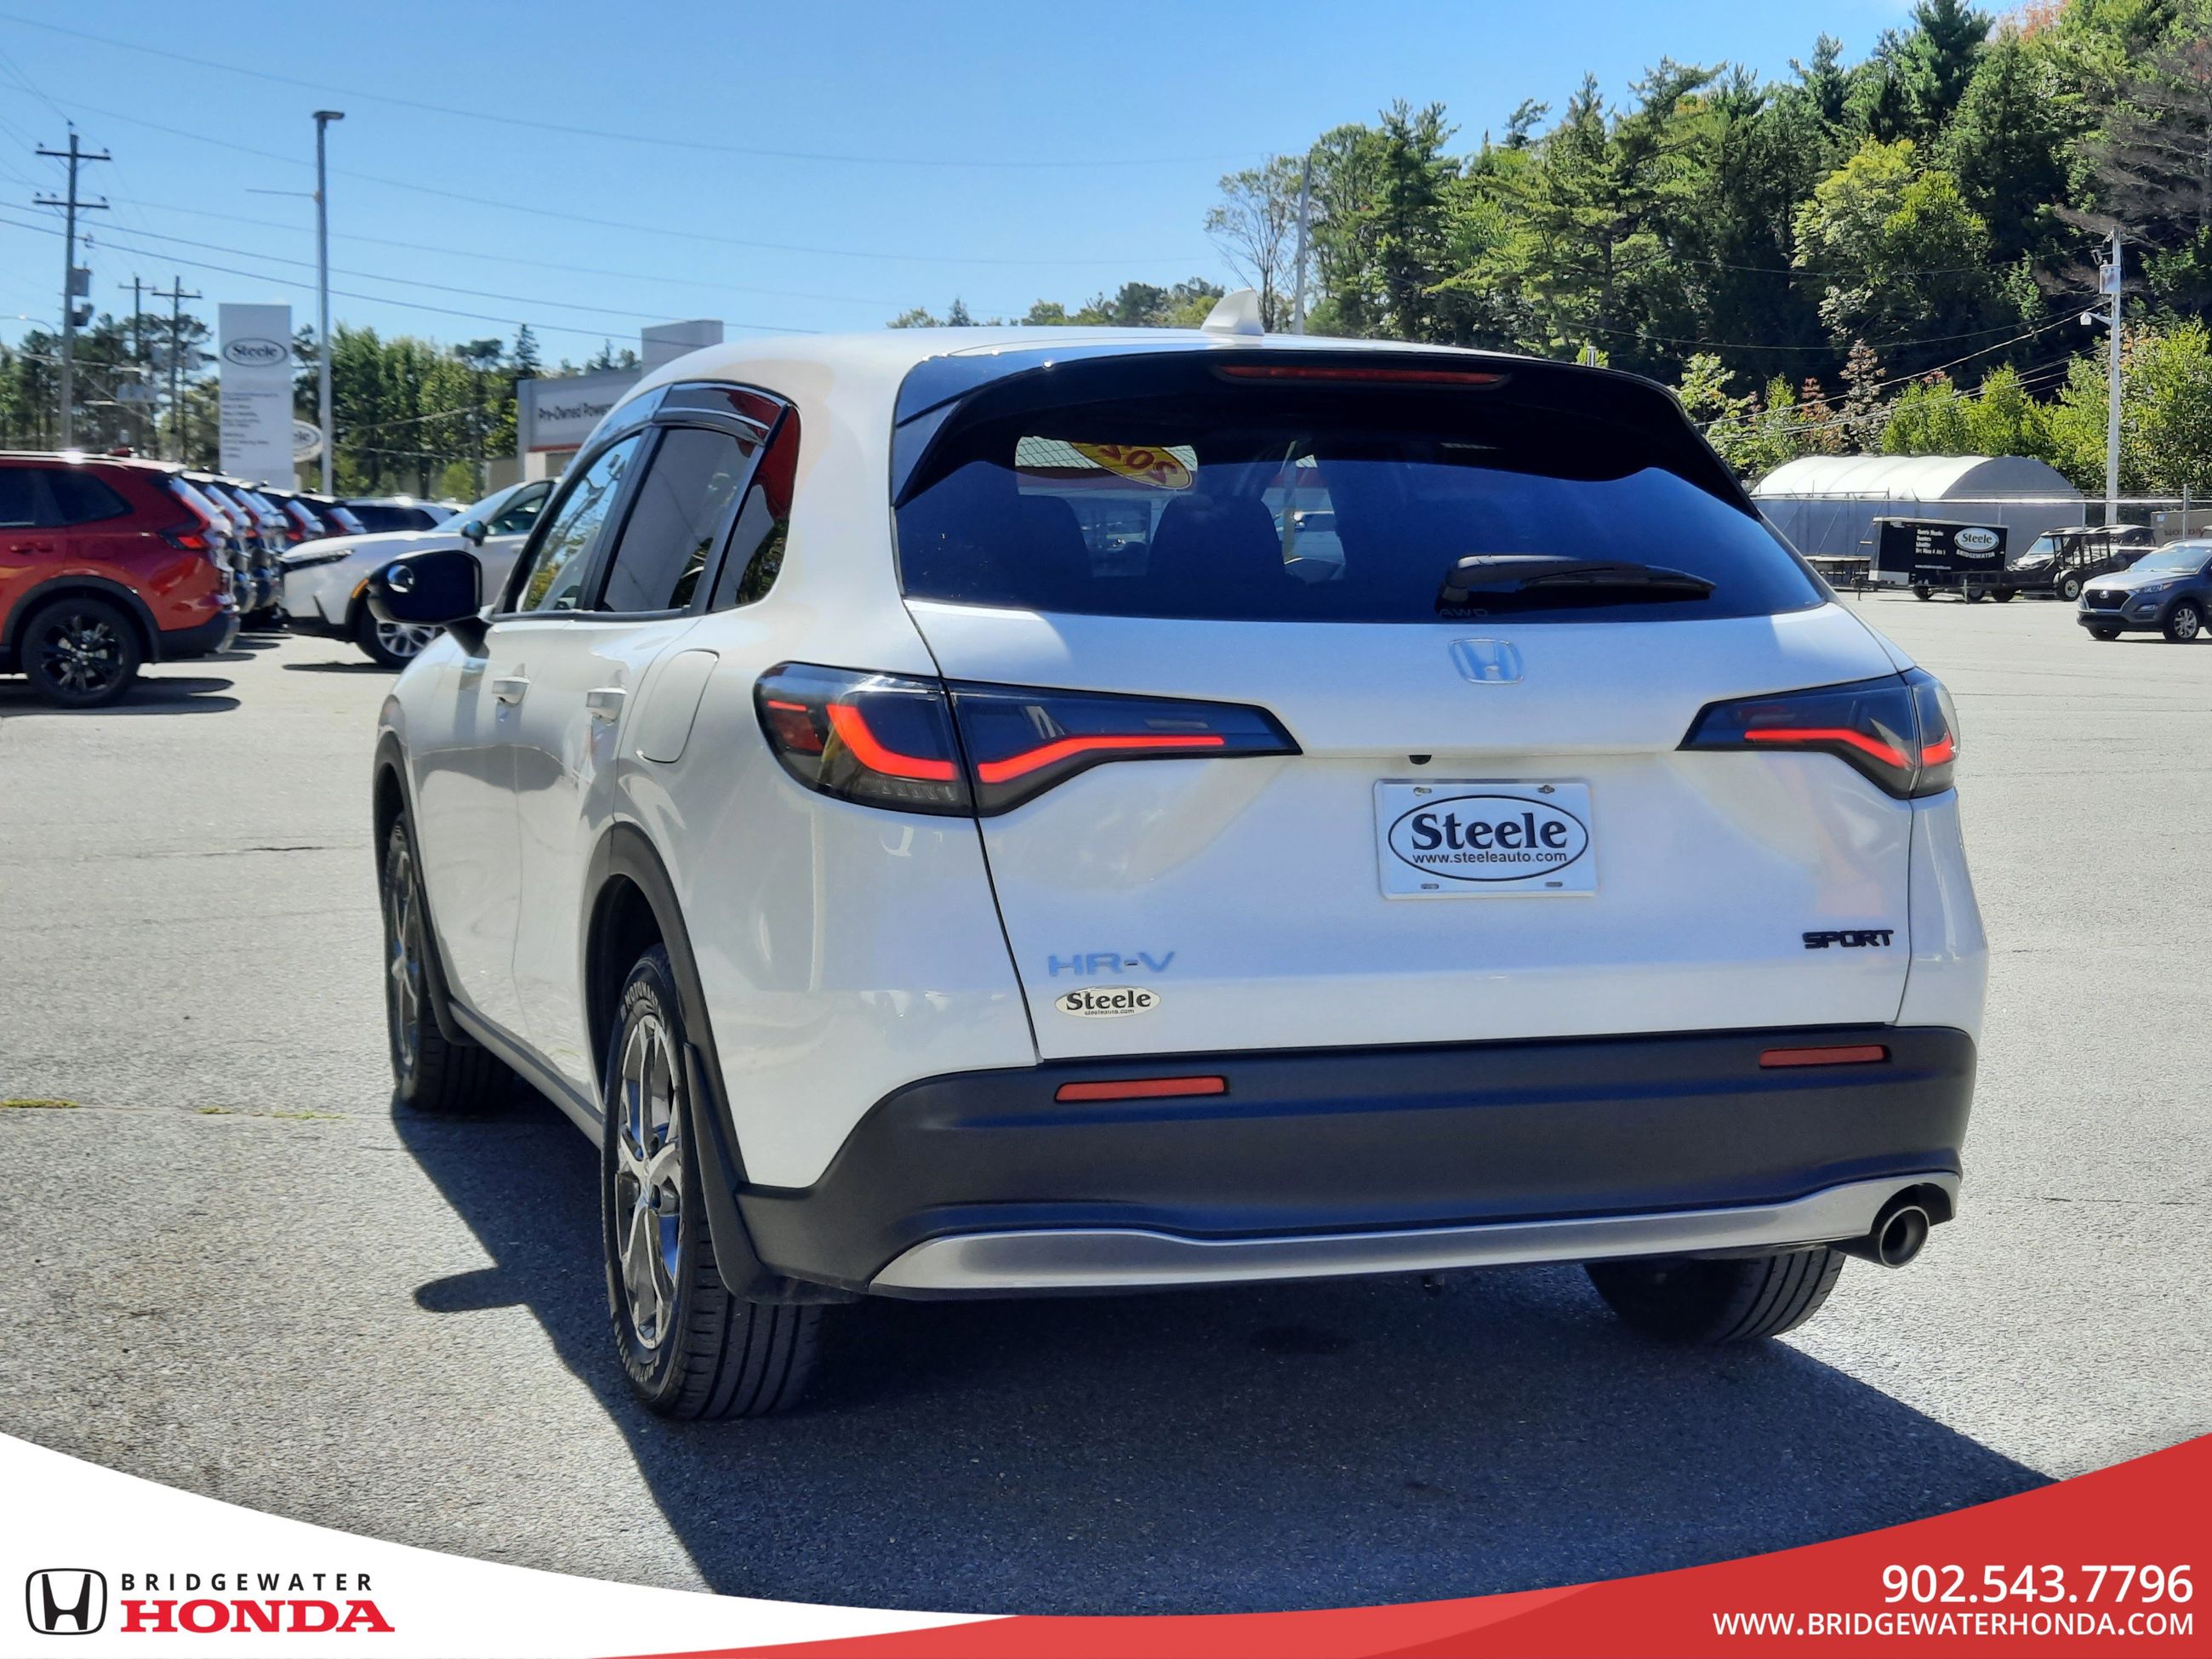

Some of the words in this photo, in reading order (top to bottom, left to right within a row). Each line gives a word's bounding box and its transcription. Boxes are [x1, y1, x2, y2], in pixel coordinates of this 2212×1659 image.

[1961, 533, 1993, 544] Steele
[1411, 812, 1568, 851] Steele
[1412, 851, 1567, 864] www.steeleauto.com
[1802, 930, 1894, 949] SPORT
[1047, 951, 1176, 977] HR-V
[1066, 989, 1152, 1011] Steele
